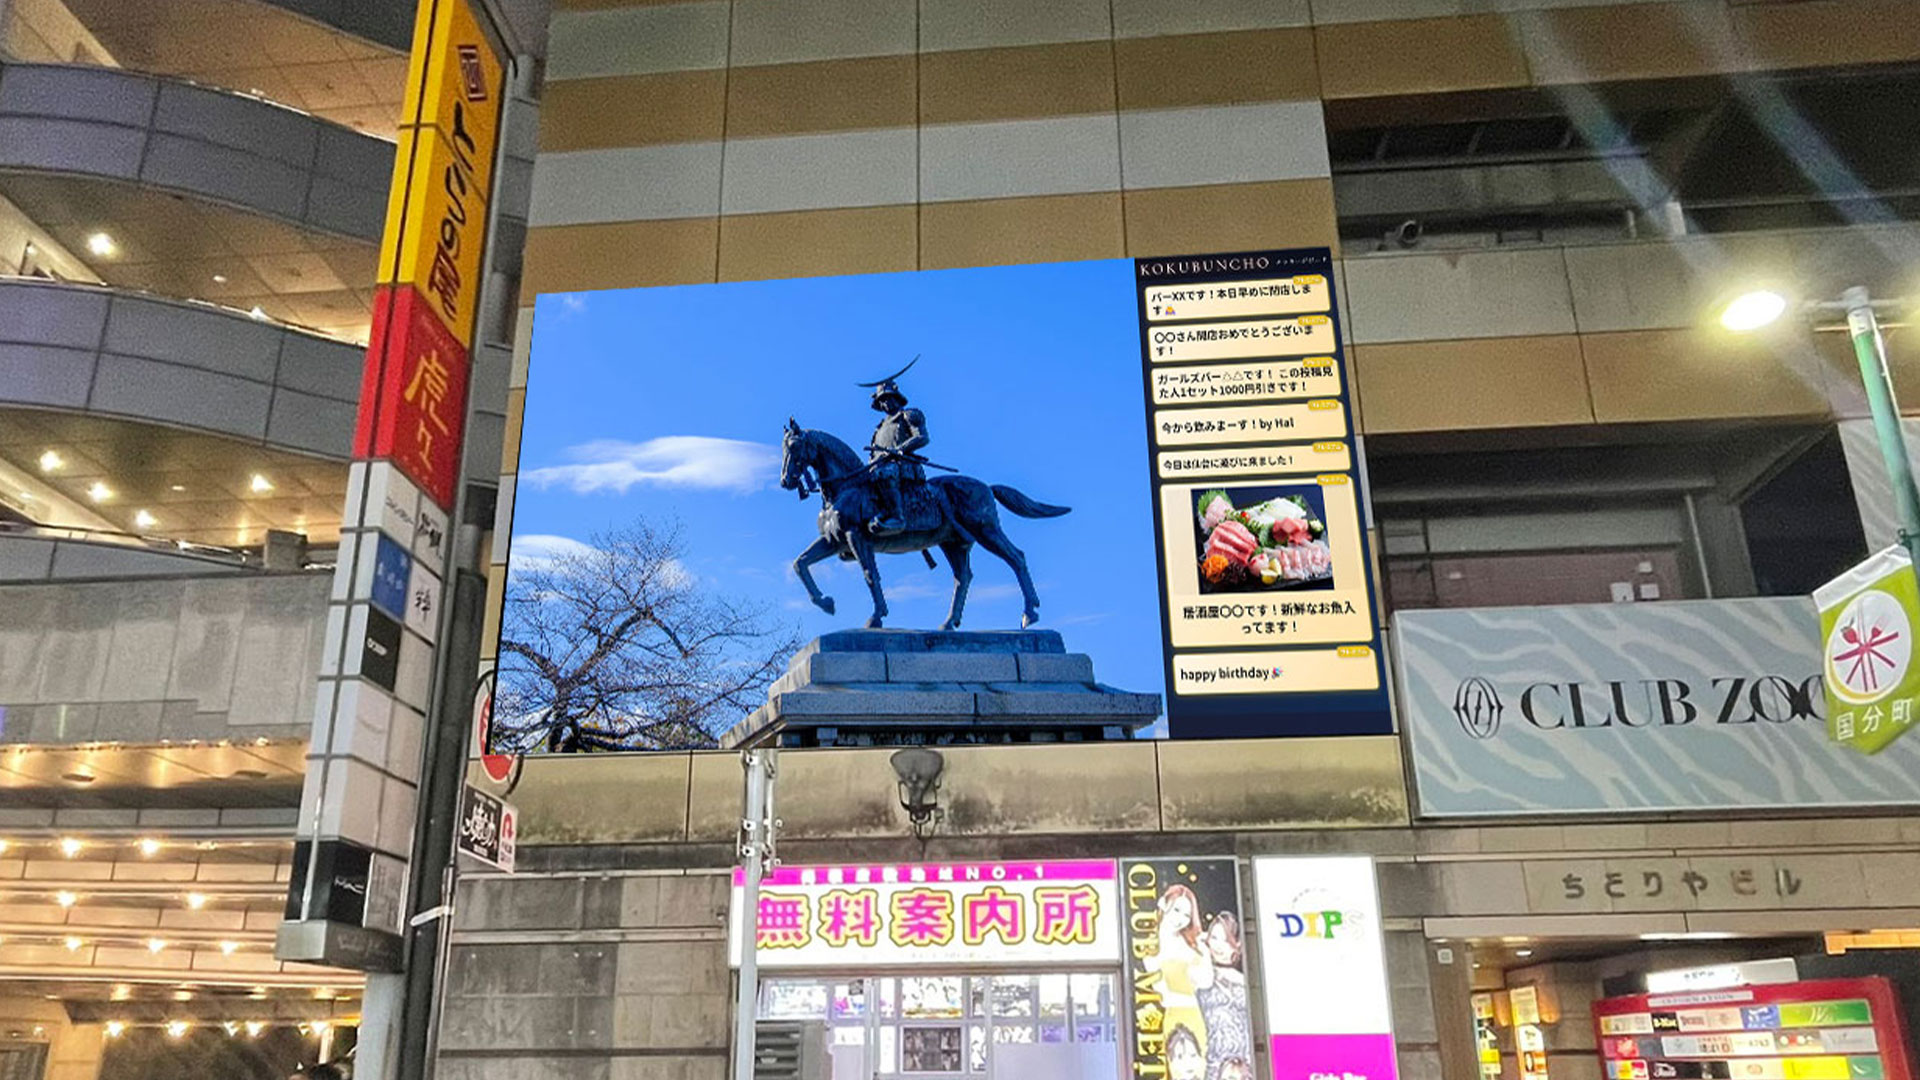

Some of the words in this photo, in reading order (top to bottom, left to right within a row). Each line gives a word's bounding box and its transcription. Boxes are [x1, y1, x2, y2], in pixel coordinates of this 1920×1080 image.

[1140, 256, 1271, 277] KOKUBUNCHO
[1153, 306, 1162, 316] す
[1241, 621, 1298, 635] ってます！
[1180, 668, 1221, 683] happy
[1219, 666, 1270, 681] birthday
[1520, 678, 1698, 730] CLUB
[1835, 698, 1914, 741] 国分町
[757, 884, 1100, 948] 無料案内所
[1128, 863, 1160, 960] CLUB
